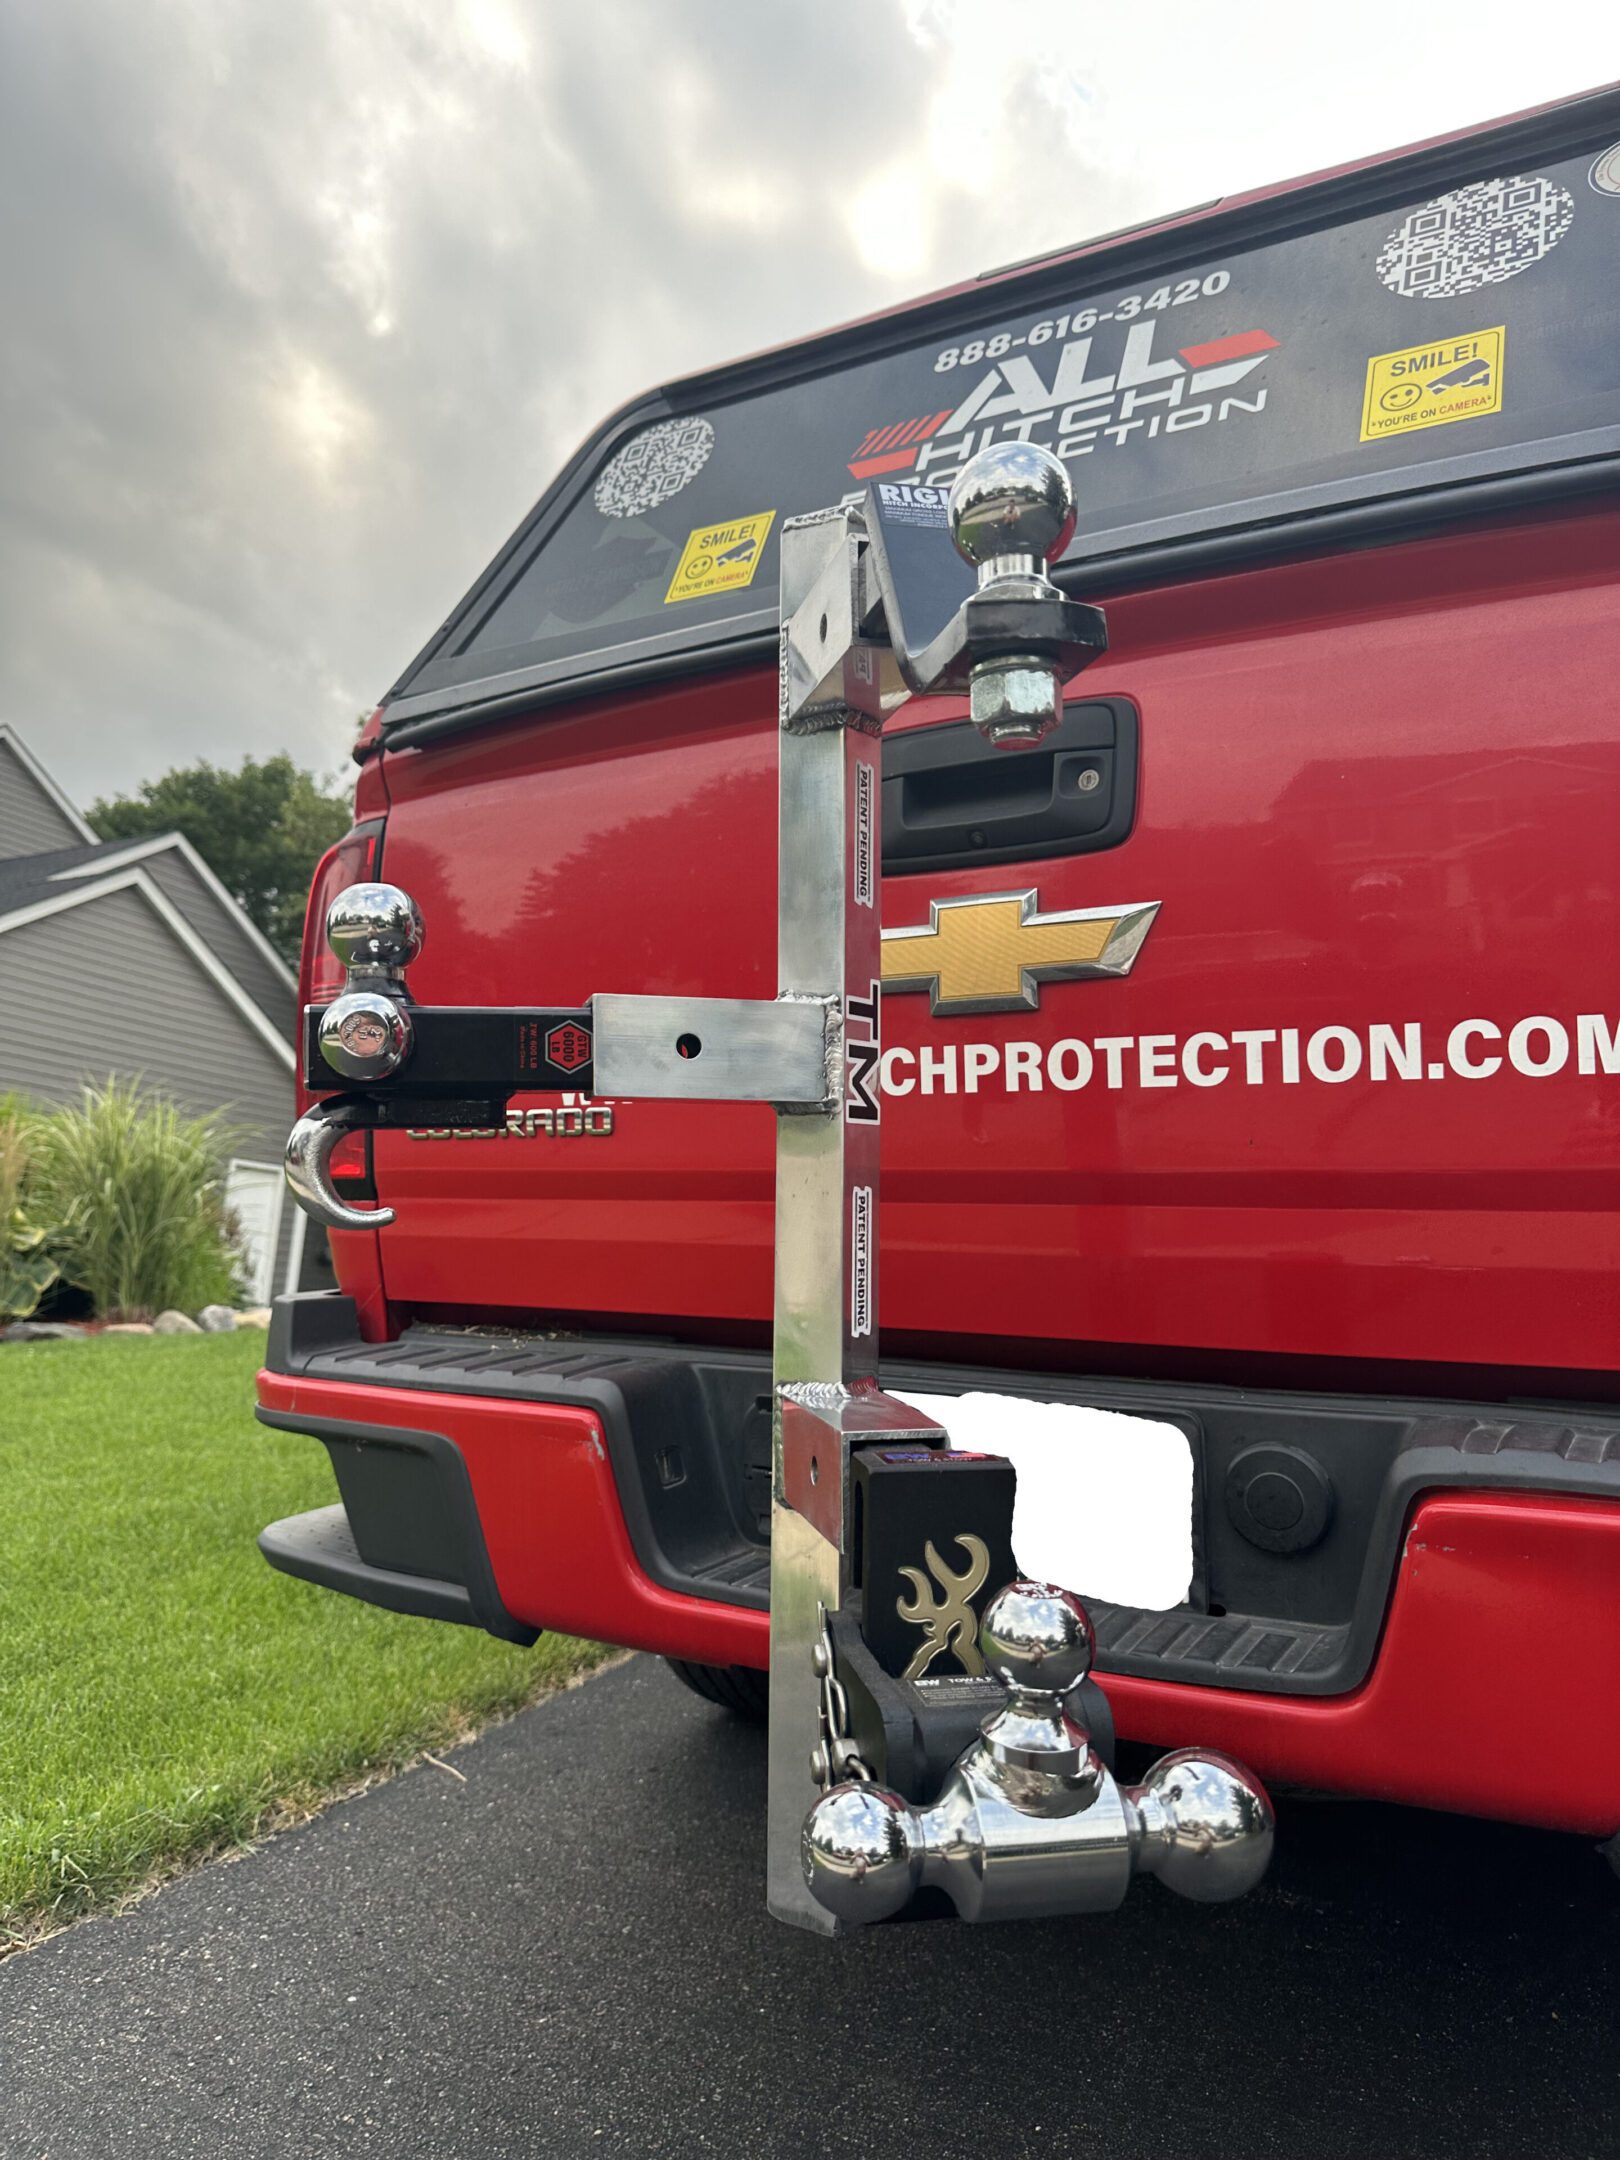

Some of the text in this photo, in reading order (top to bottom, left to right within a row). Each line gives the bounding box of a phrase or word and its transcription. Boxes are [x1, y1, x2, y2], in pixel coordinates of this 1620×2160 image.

[934, 270, 1231, 373] 888-616-3420
[1390, 342, 1479, 377] SMILE!
[936, 319, 1187, 437] ALL
[915, 372, 1186, 471] HITCH
[1420, 408, 1436, 419] ON
[1439, 397, 1487, 415] CAMERA
[699, 523, 756, 549] SMILE!
[860, 769, 868, 898] PATENT PENDING
[552, 1041, 560, 1053] LB
[563, 1031, 574, 1062] 6000
[578, 1035, 587, 1058] GTW
[857, 1195, 866, 1327] PATENT PENDING
